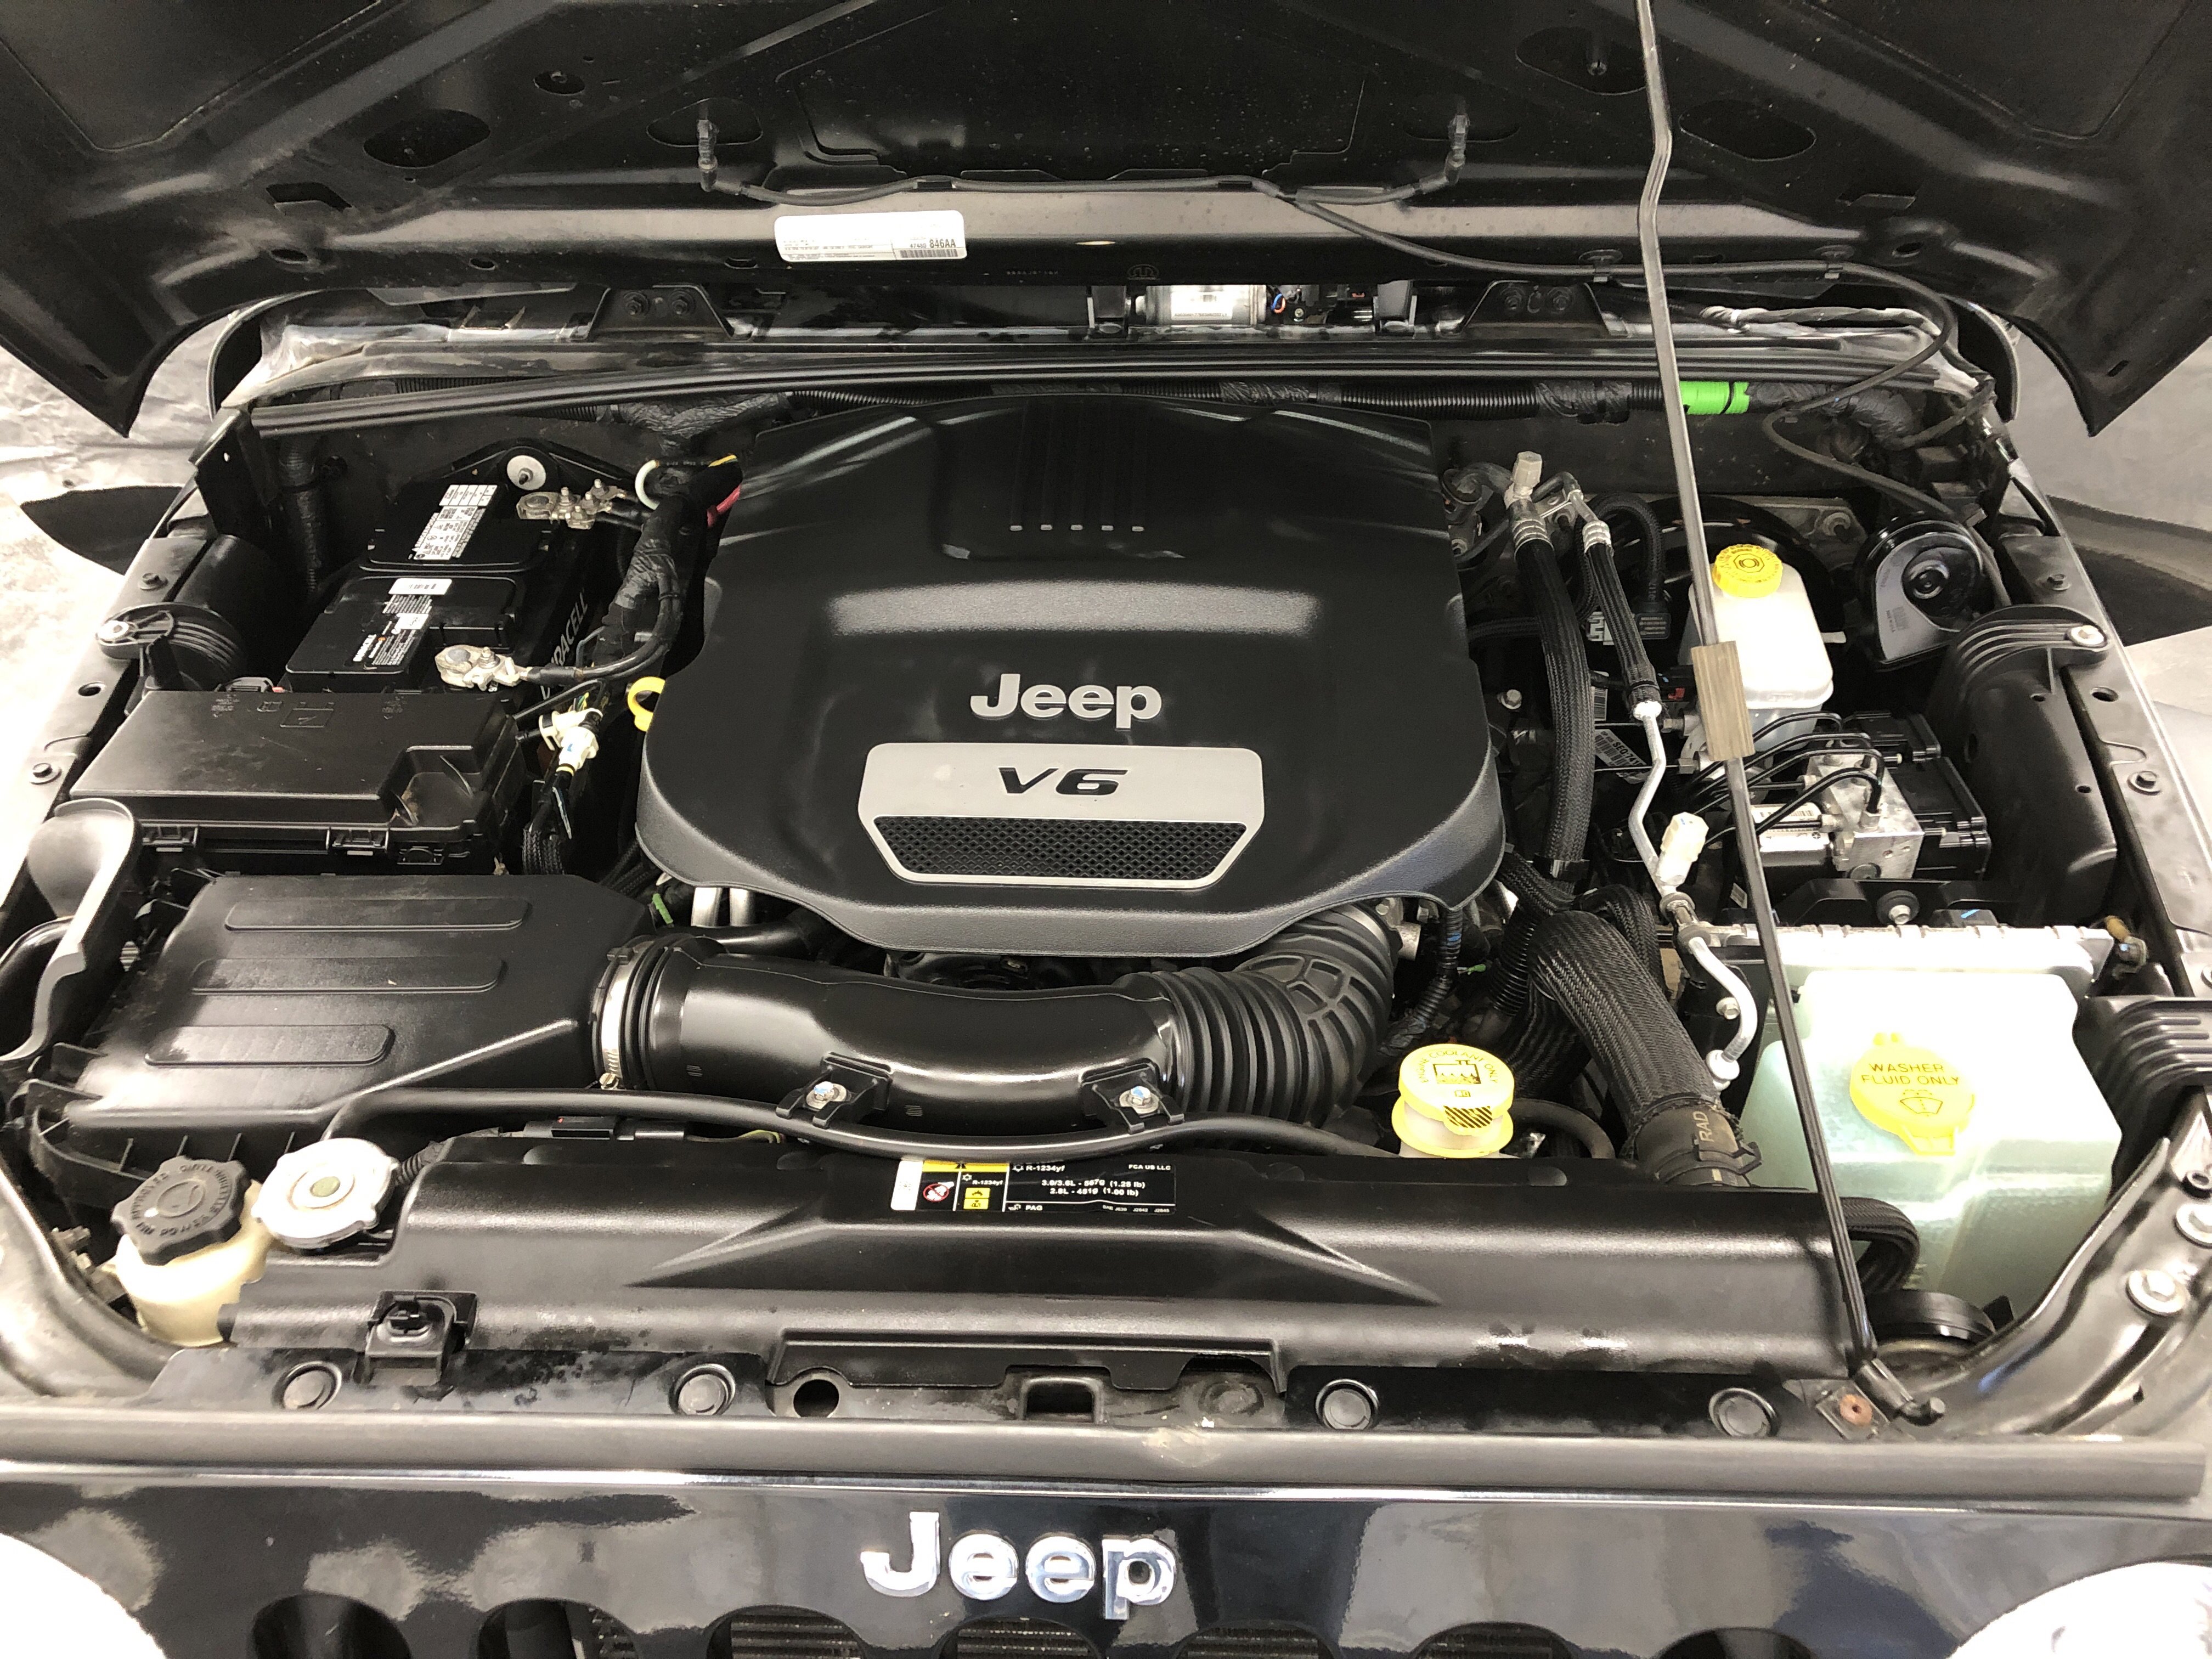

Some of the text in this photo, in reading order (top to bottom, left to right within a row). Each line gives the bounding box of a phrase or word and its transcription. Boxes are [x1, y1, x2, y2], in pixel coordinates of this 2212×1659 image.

[929, 238, 956, 248] 846AA
[970, 673, 1163, 730] Jeep
[998, 766, 1128, 795] V6
[1417, 1050, 1499, 1084] ENGINE COOLANT ONLY
[1869, 1063, 1945, 1073] WASHER
[1861, 1075, 1959, 1085] FLUID ONLY
[1692, 1111, 1715, 1143] RAD
[1025, 1165, 1065, 1173] R-1234yf
[1133, 1181, 1146, 1189] lb)
[1103, 1187, 1125, 1195] (1.00
[1126, 1189, 1139, 1197] lb)
[860, 1511, 1176, 1620] Jeep
